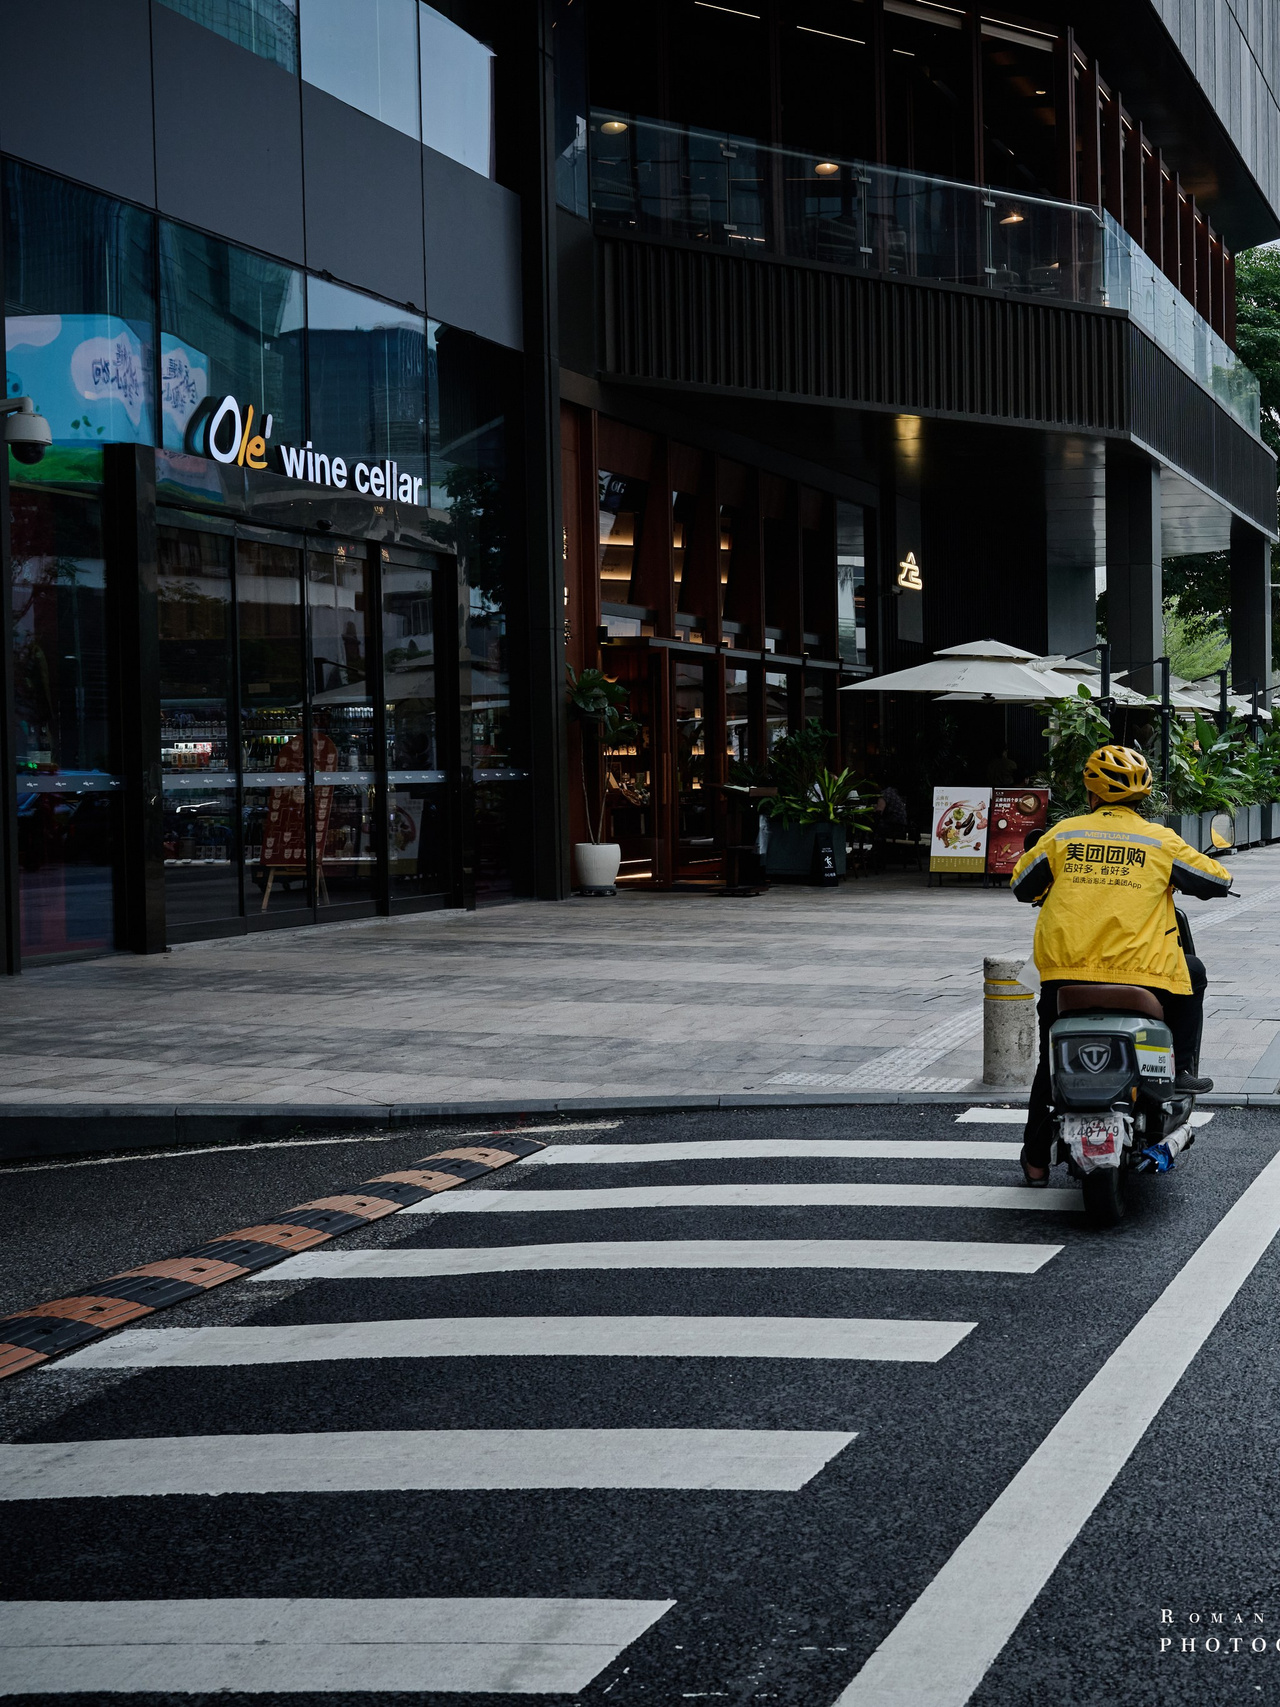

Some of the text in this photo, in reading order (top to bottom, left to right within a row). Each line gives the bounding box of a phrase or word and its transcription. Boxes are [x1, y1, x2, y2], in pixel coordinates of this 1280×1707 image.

[280, 440, 348, 489] wine
[355, 459, 422, 505] cellar
[1084, 831, 1130, 841] MEITUAN
[1066, 843, 1146, 868] 美团团购
[1141, 1063, 1167, 1074] RUNNING
